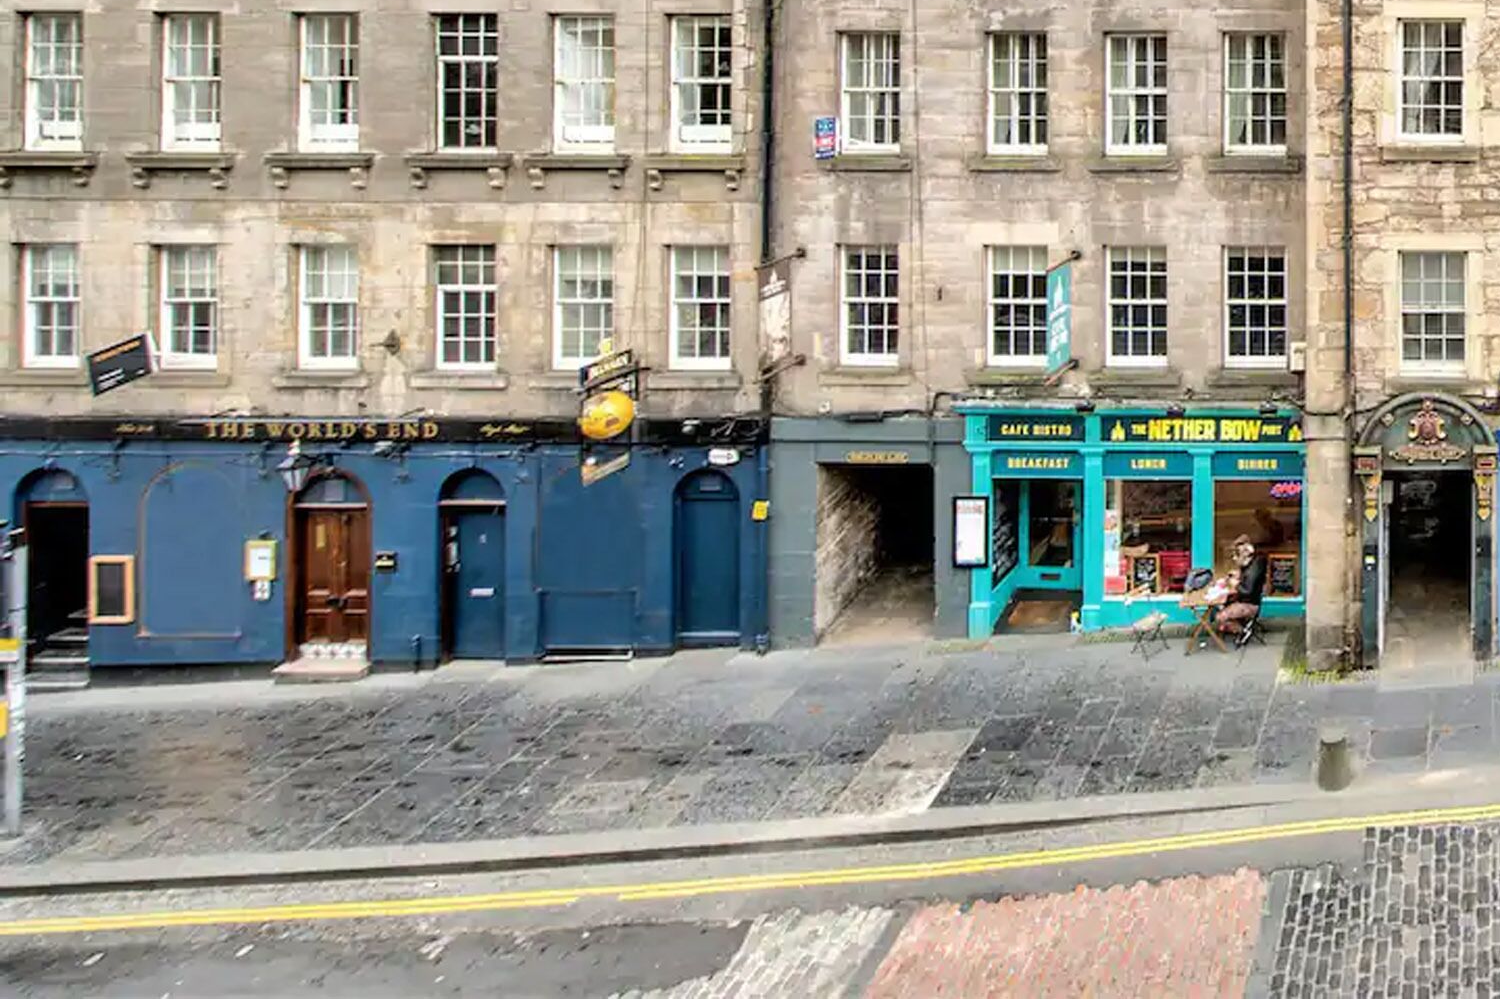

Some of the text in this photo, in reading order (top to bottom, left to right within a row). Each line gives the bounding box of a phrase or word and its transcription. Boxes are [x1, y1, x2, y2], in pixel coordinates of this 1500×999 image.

[206, 422, 439, 439] THE WORLD'S END
[1000, 424, 1073, 437] CAFE BISTRO
[1131, 423, 1147, 435] THE
[1148, 419, 1217, 441] NETHER
[1220, 419, 1263, 441] BOW
[1007, 457, 1070, 469] BREAKFAST
